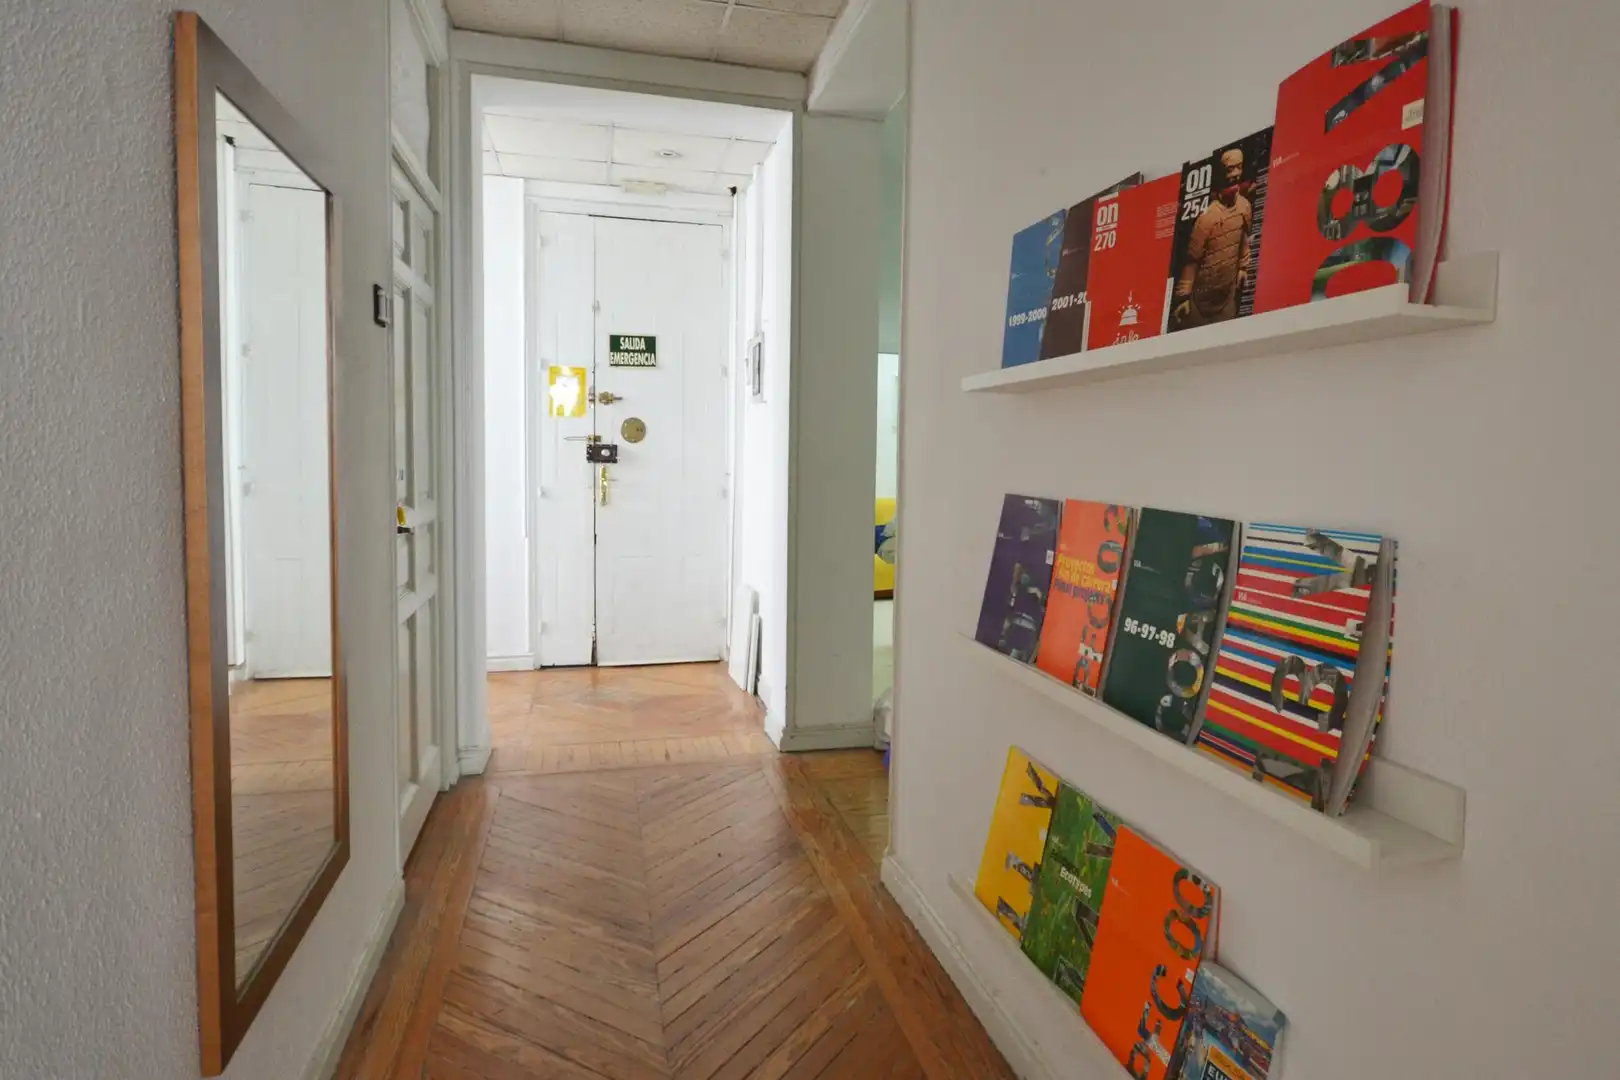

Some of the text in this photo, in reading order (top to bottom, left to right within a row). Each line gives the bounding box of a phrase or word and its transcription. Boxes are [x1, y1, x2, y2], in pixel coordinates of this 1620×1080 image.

[1185, 164, 1212, 193] on
[1096, 202, 1119, 226] on
[1181, 195, 1210, 221] 254
[1094, 231, 1117, 252] 270
[1009, 307, 1048, 327] 1999-2000
[620, 336, 646, 350] SALIDA
[610, 351, 656, 365] EMERGENCIA
